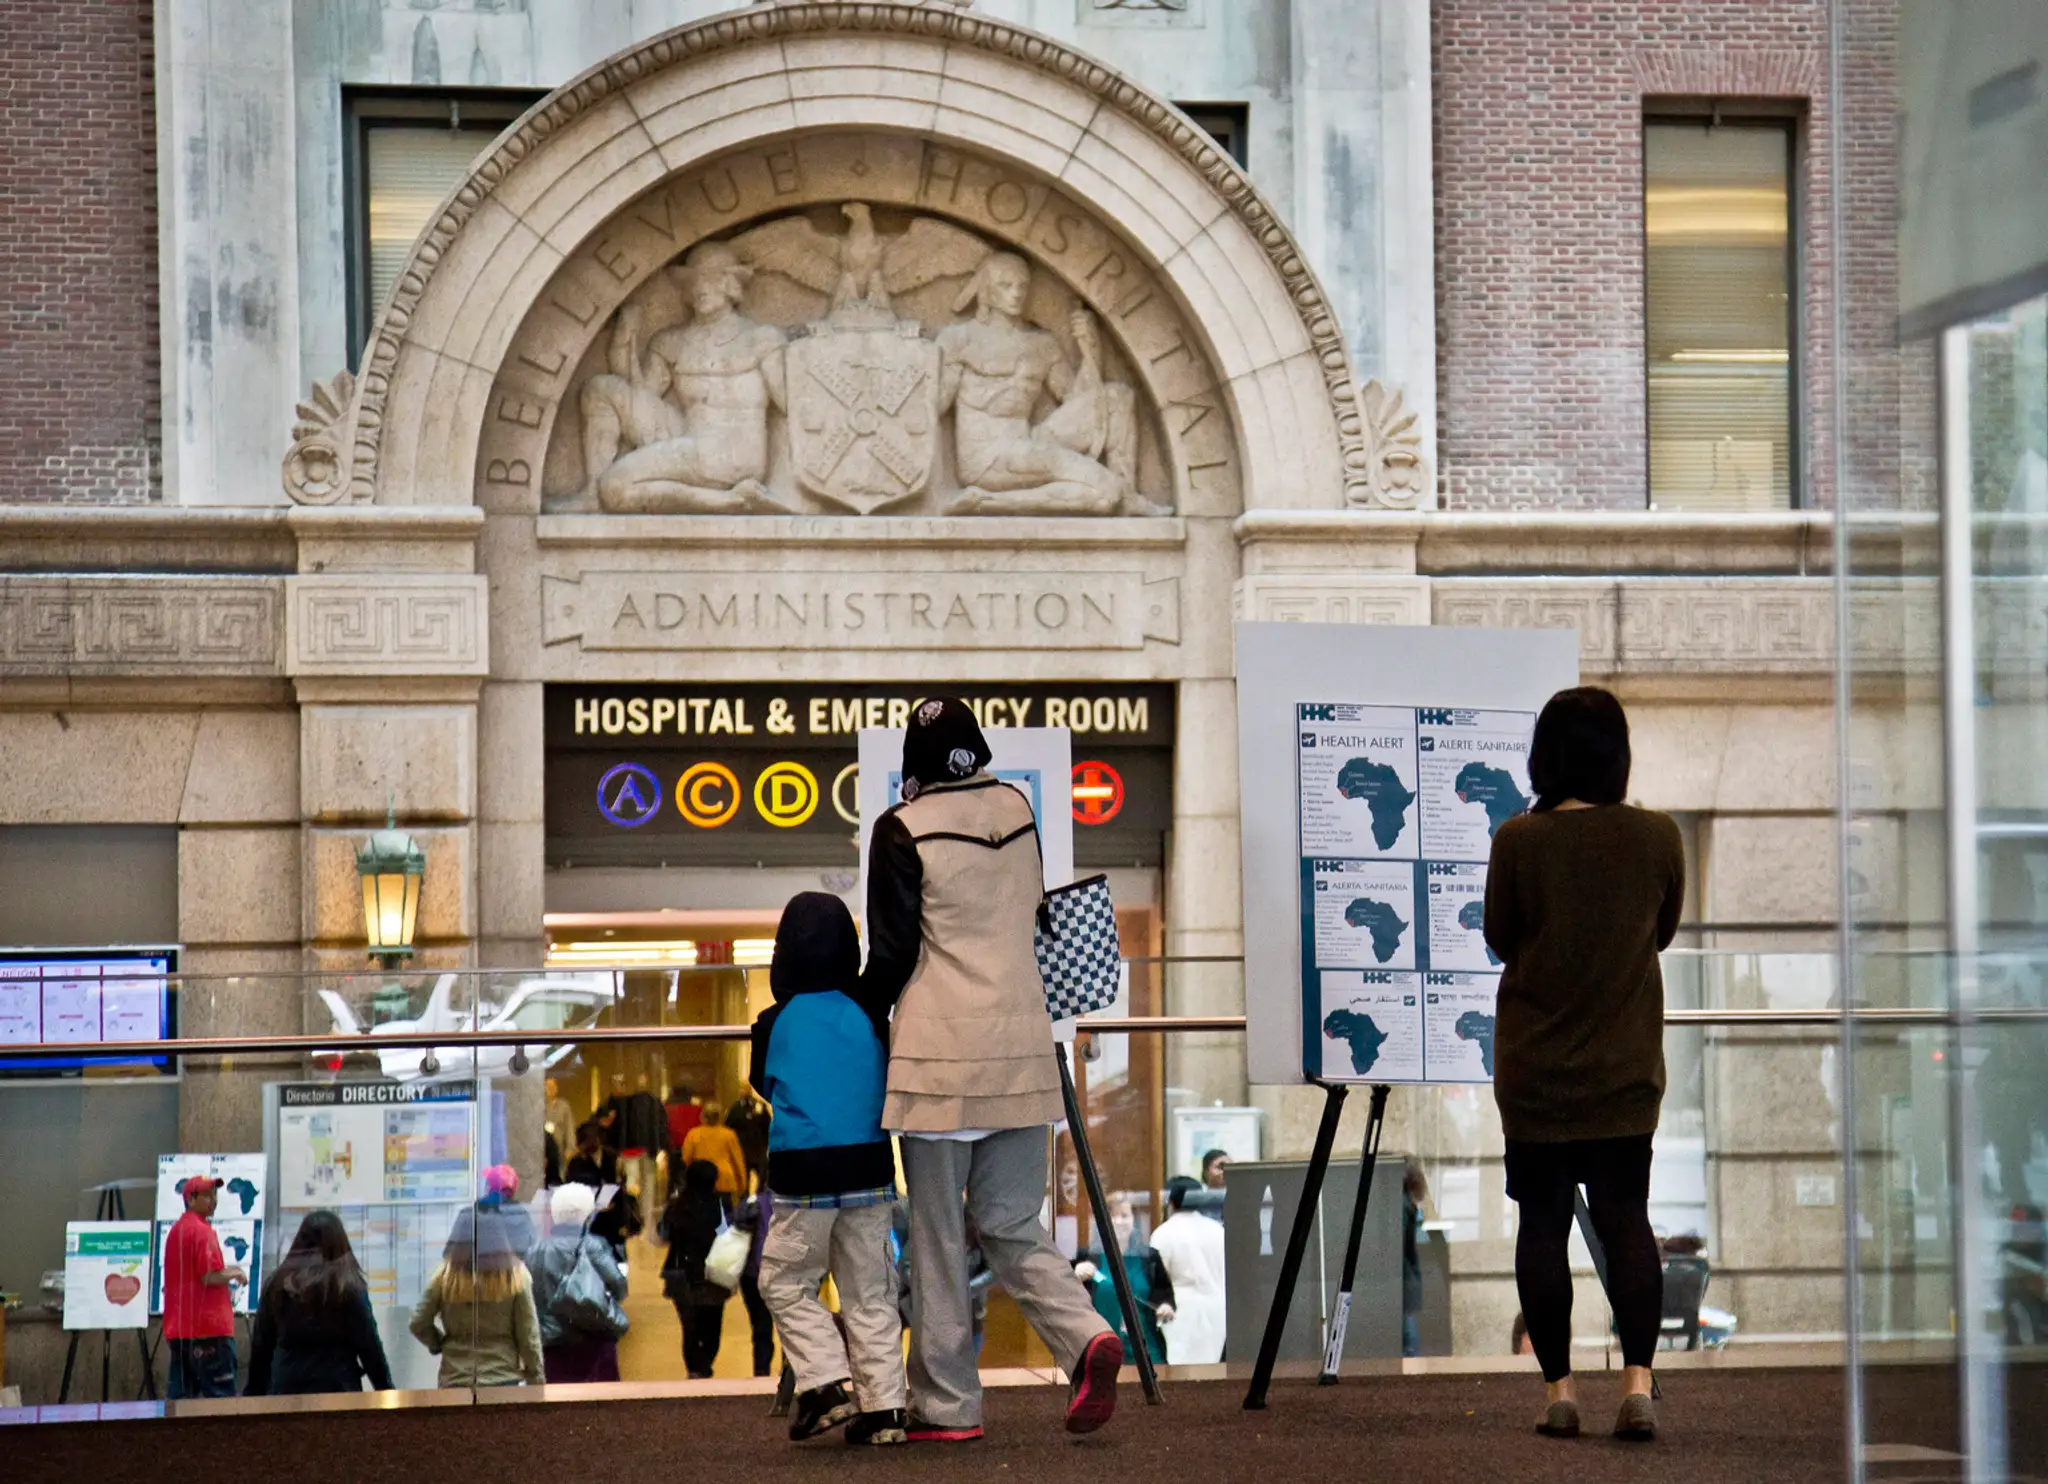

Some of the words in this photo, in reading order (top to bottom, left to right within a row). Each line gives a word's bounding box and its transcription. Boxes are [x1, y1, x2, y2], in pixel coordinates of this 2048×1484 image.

[486, 151, 799, 488] BELLEVUE
[923, 150, 1228, 489] HOSPITAL
[612, 592, 1115, 630] ADMINISTRATION
[574, 697, 754, 734] HOSPITAL
[766, 697, 796, 734] &
[809, 697, 1031, 734] EMERCY
[1046, 697, 1148, 732] ROOM
[1301, 704, 1335, 721] HHC
[1419, 708, 1453, 725] HHC
[1321, 735, 1366, 747] HEALTH
[1370, 737, 1404, 748] ALERT
[1439, 739, 1473, 750] ALERTE
[1476, 741, 1528, 753] SANITAIRE
[1332, 882, 1362, 890] ALERTA
[1364, 883, 1408, 891] SANITARIA
[286, 1089, 335, 1103] Directorio
[342, 1085, 427, 1102] DIRECTORY
